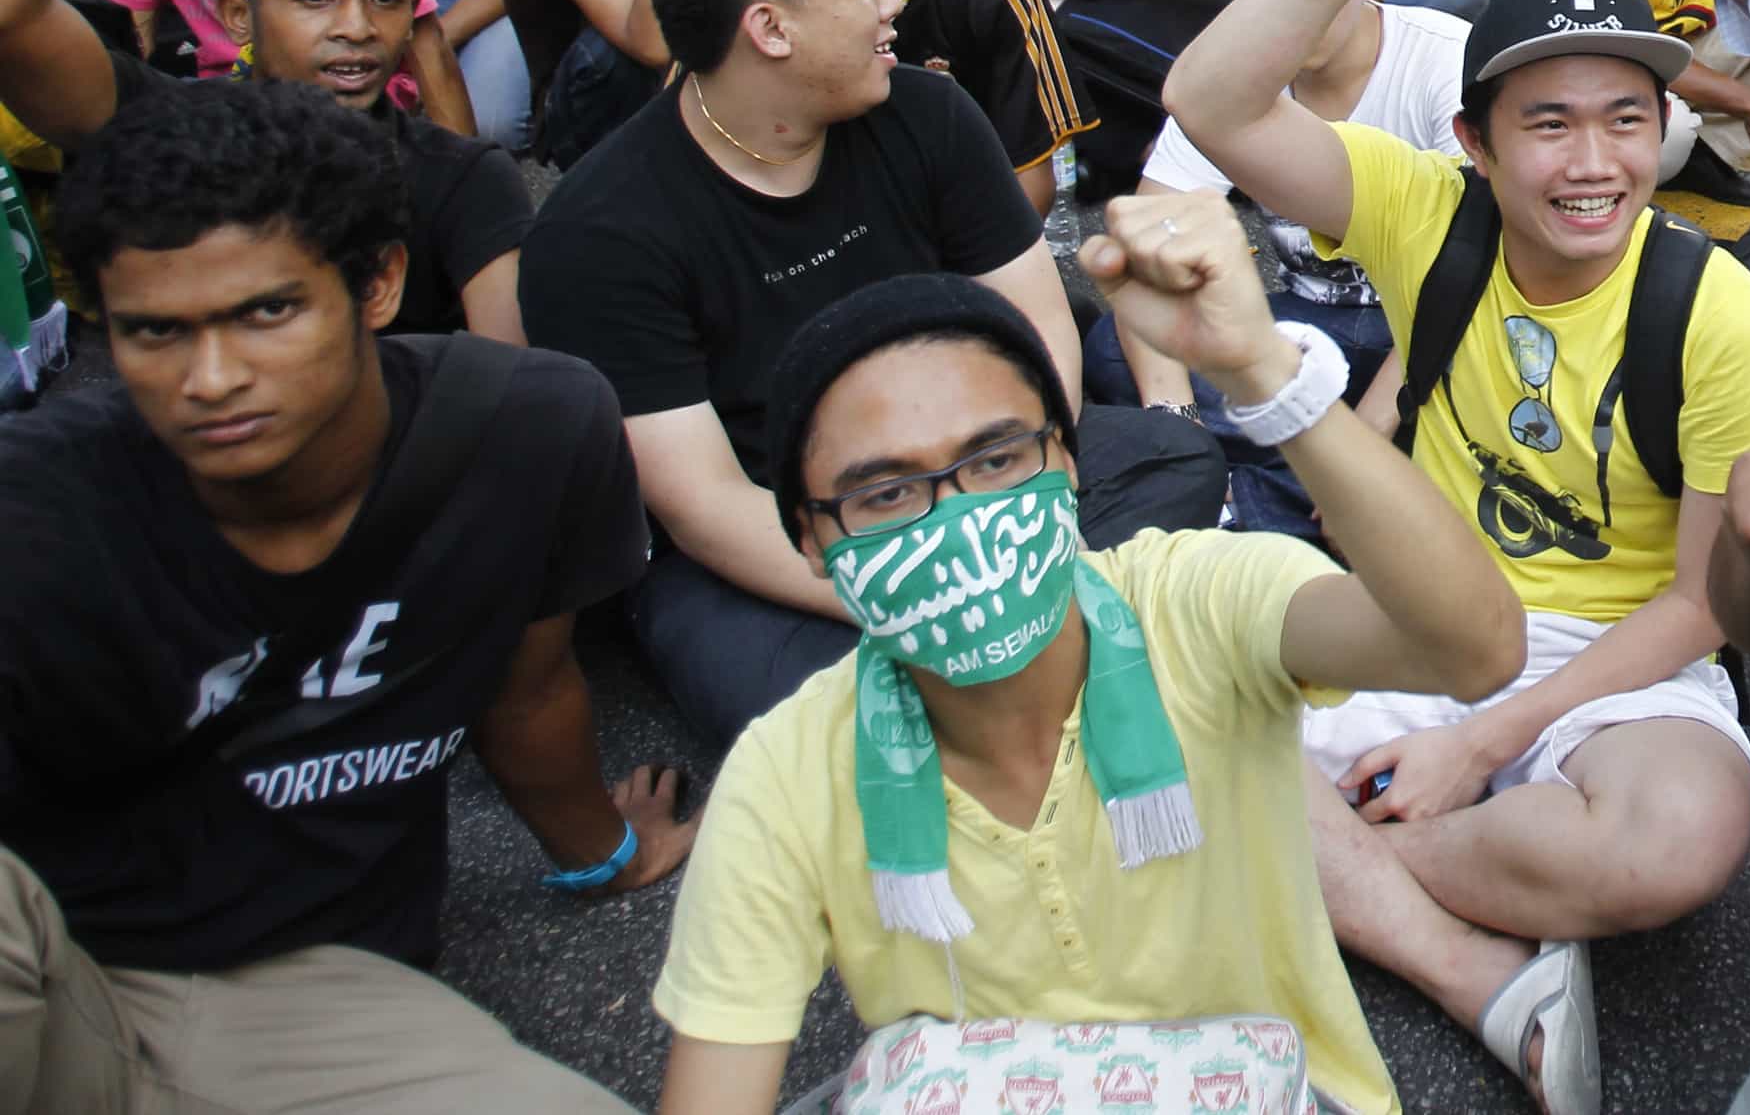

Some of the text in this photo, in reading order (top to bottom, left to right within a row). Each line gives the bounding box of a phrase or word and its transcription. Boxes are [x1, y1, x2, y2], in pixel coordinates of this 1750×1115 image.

[788, 264, 806, 276] on
[811, 248, 836, 266] the
[840, 225, 868, 245] ach
[243, 727, 466, 810] PORTSWEAR
